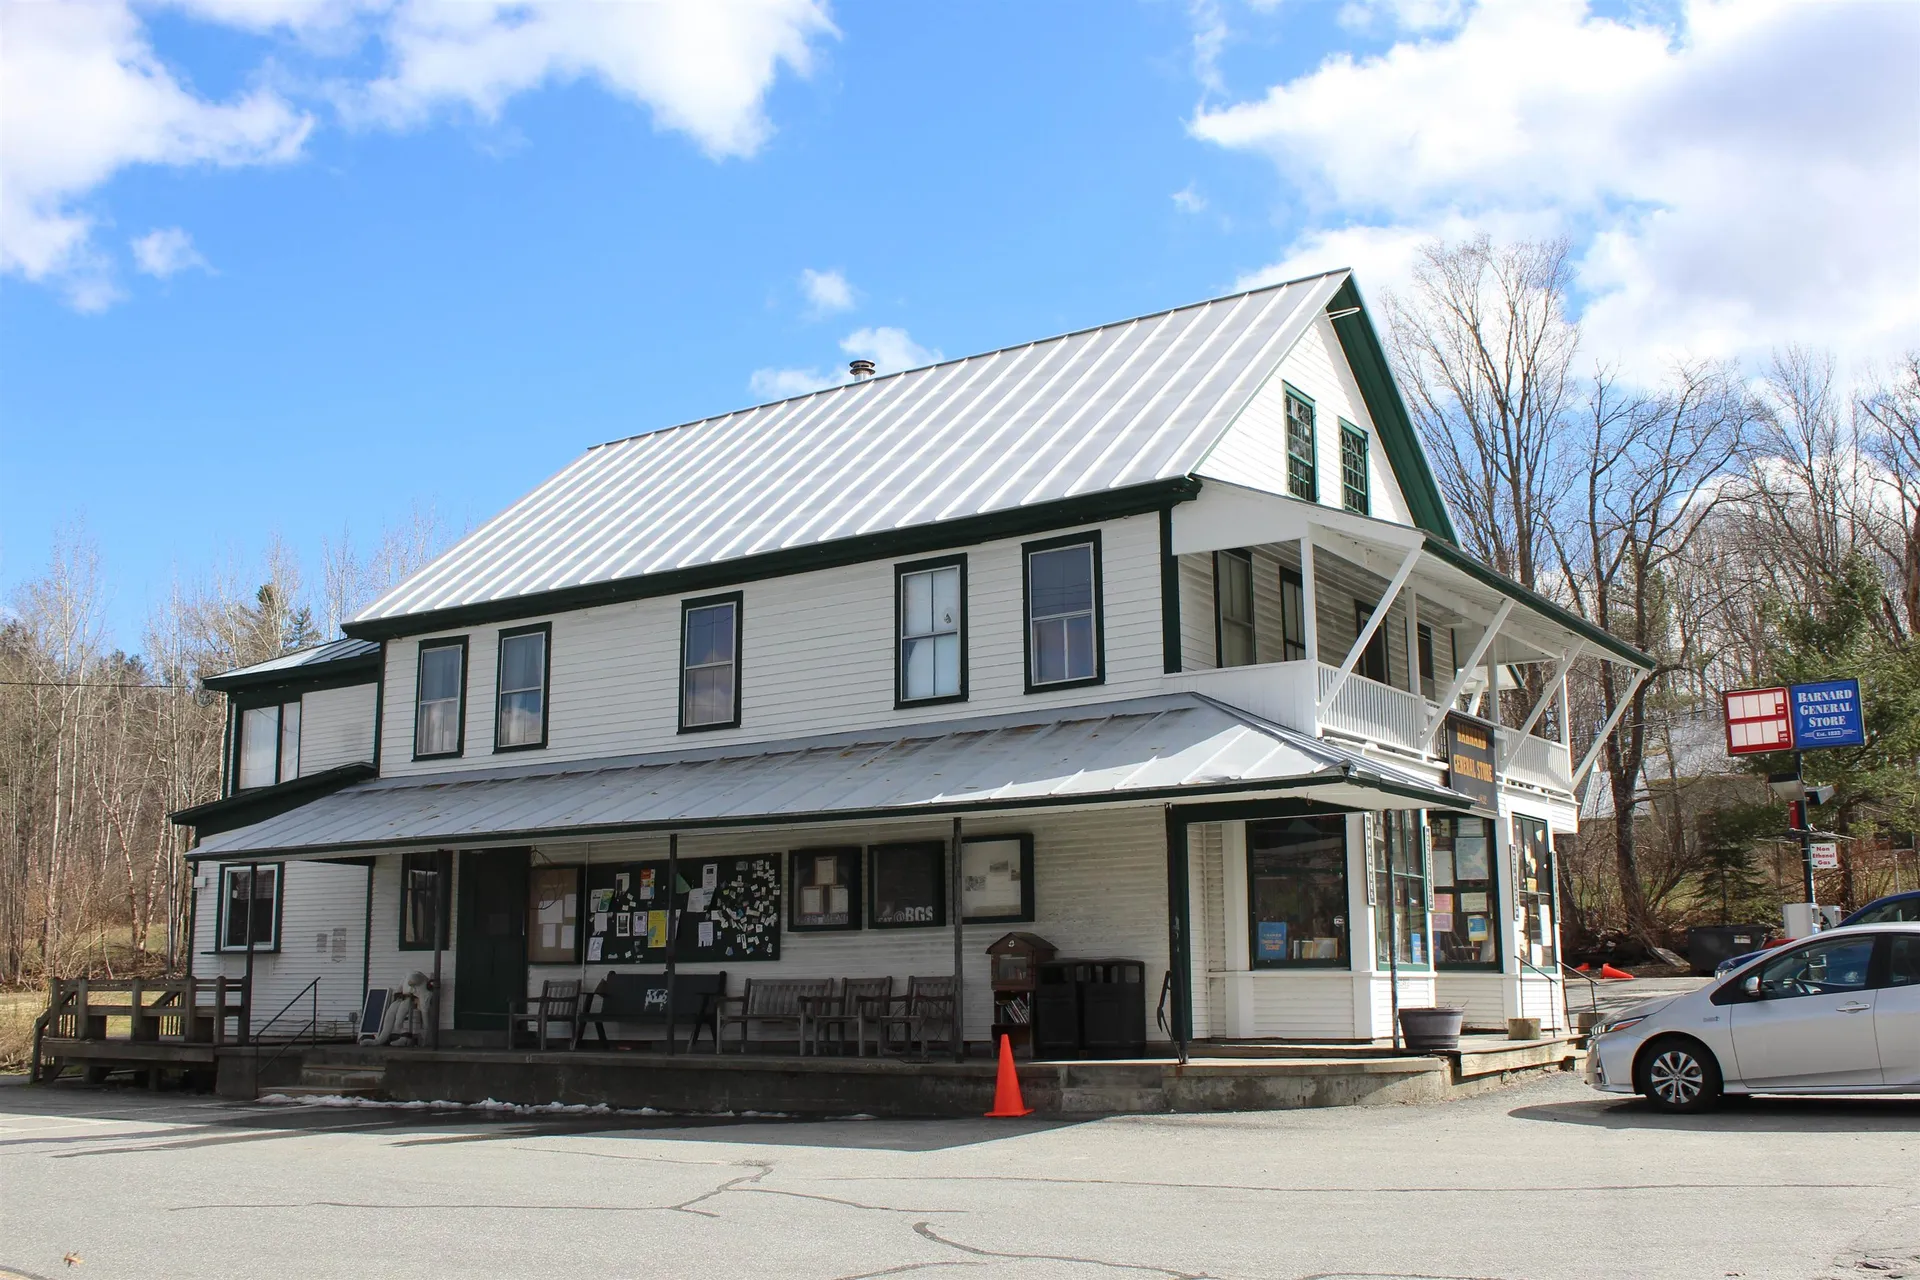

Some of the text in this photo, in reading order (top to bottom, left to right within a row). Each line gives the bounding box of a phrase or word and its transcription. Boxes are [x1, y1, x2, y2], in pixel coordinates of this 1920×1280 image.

[1798, 689, 1853, 703] BARNARD
[1800, 702, 1853, 716] GENERAL
[1809, 716, 1846, 728] STORE
[1454, 754, 1493, 783] GENERAL STORE
